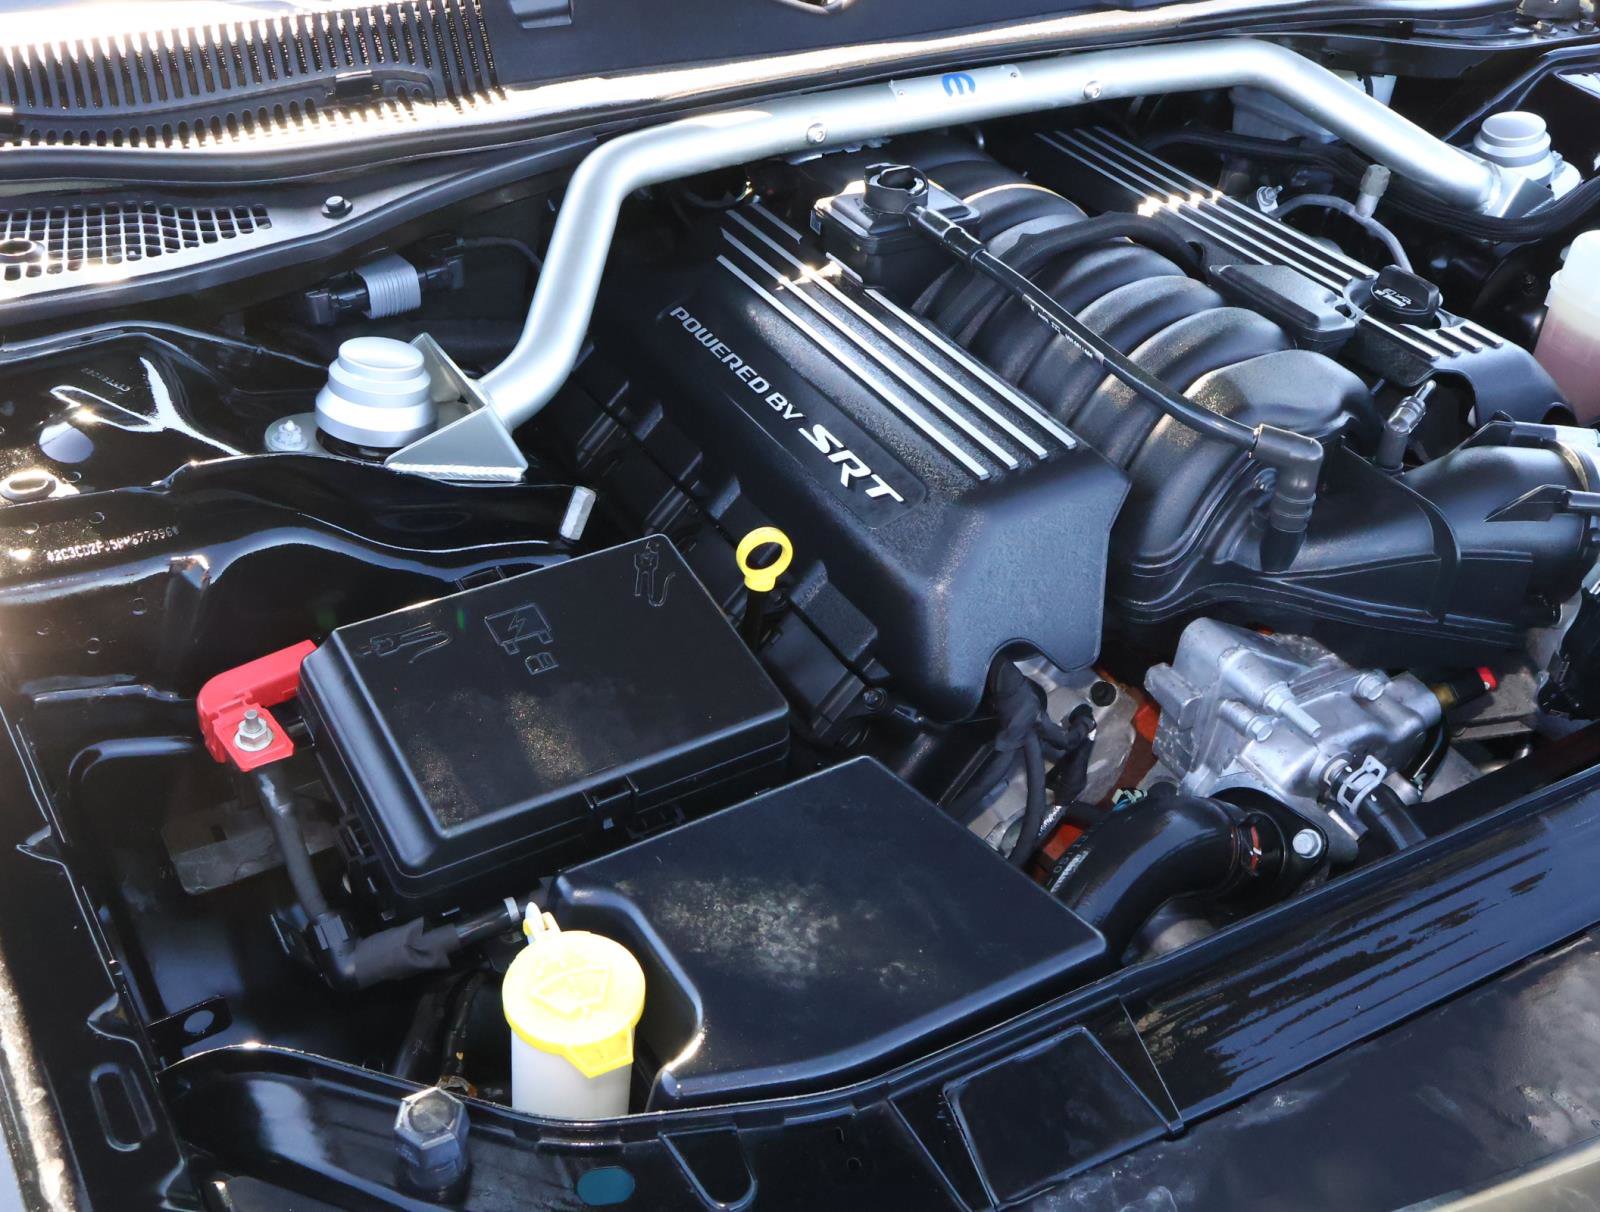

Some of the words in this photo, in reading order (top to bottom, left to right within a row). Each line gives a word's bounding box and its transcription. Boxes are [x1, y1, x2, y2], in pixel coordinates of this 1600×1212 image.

[670, 307, 770, 394] POWERED
[765, 392, 804, 421] BY
[798, 424, 904, 502] SRT
